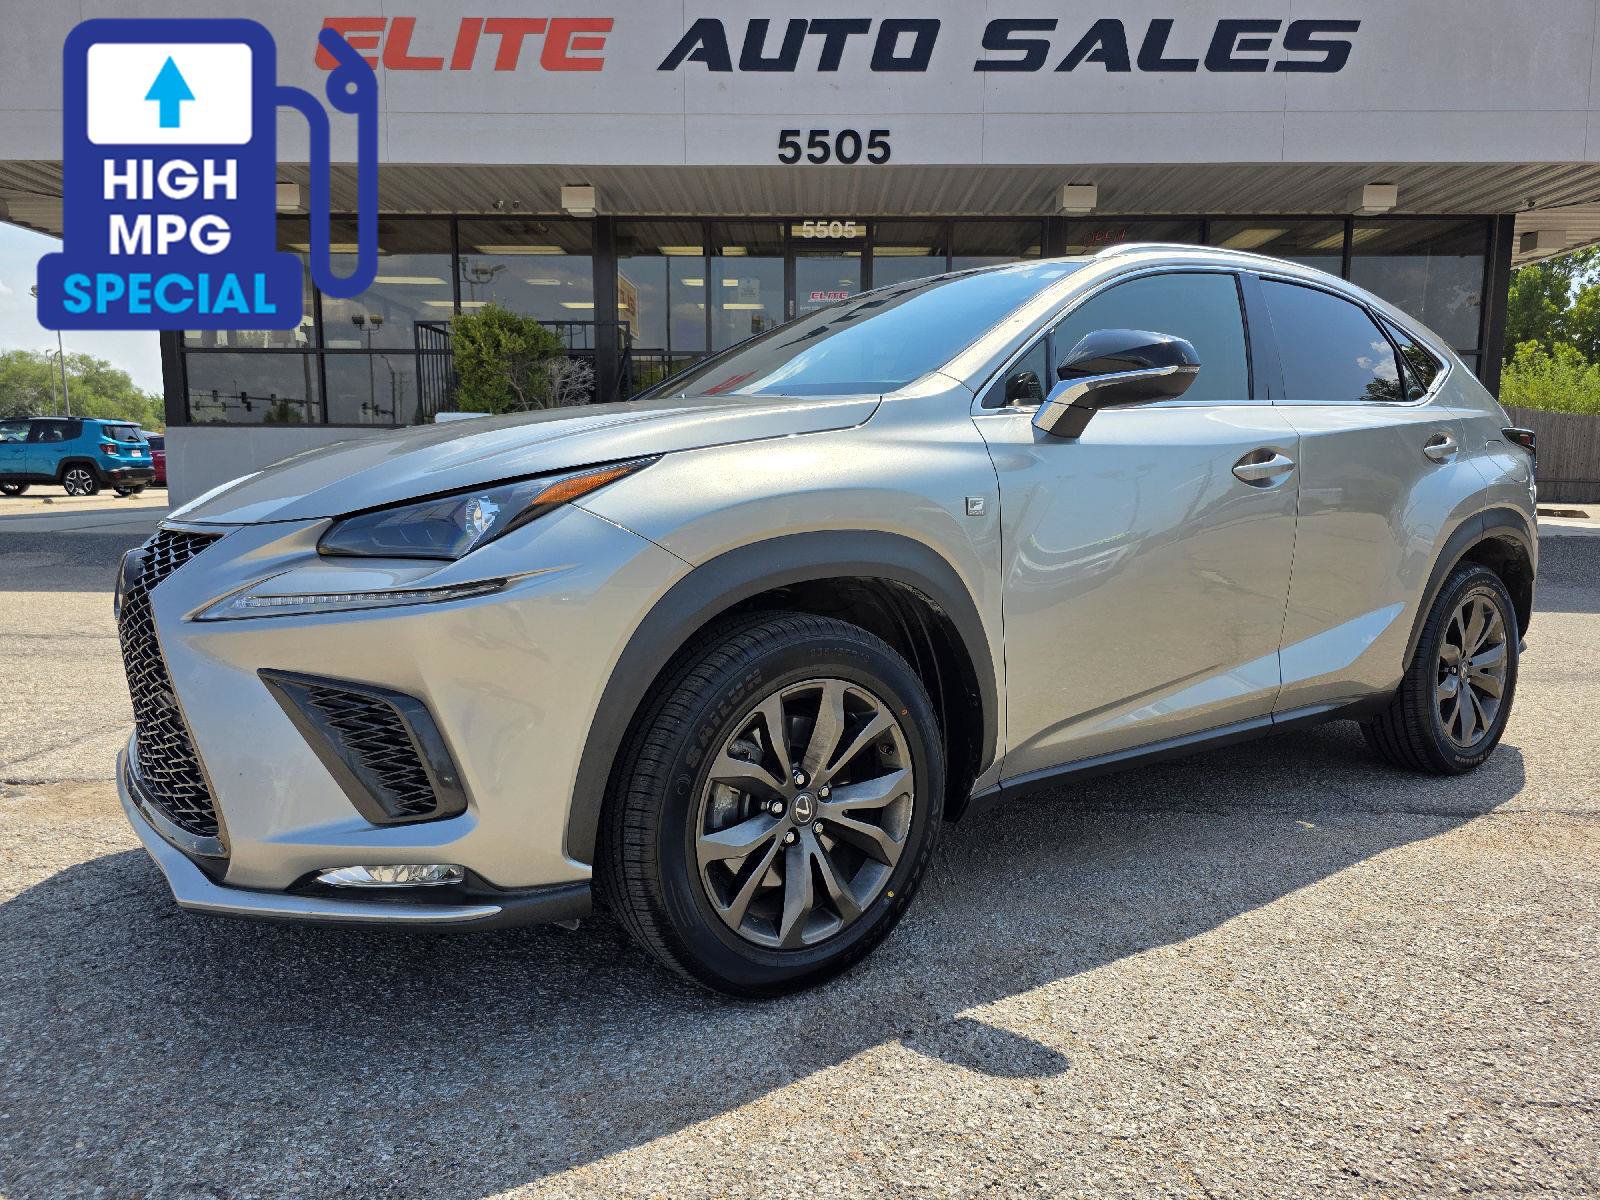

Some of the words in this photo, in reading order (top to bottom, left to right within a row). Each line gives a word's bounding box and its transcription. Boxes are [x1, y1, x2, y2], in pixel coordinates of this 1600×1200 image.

[314, 17, 614, 72] ELITE
[656, 18, 941, 73] AUTO
[973, 18, 1361, 73] SALES
[778, 129, 891, 165] 5505
[802, 221, 857, 239] 5505
[810, 291, 848, 300] ELITE
